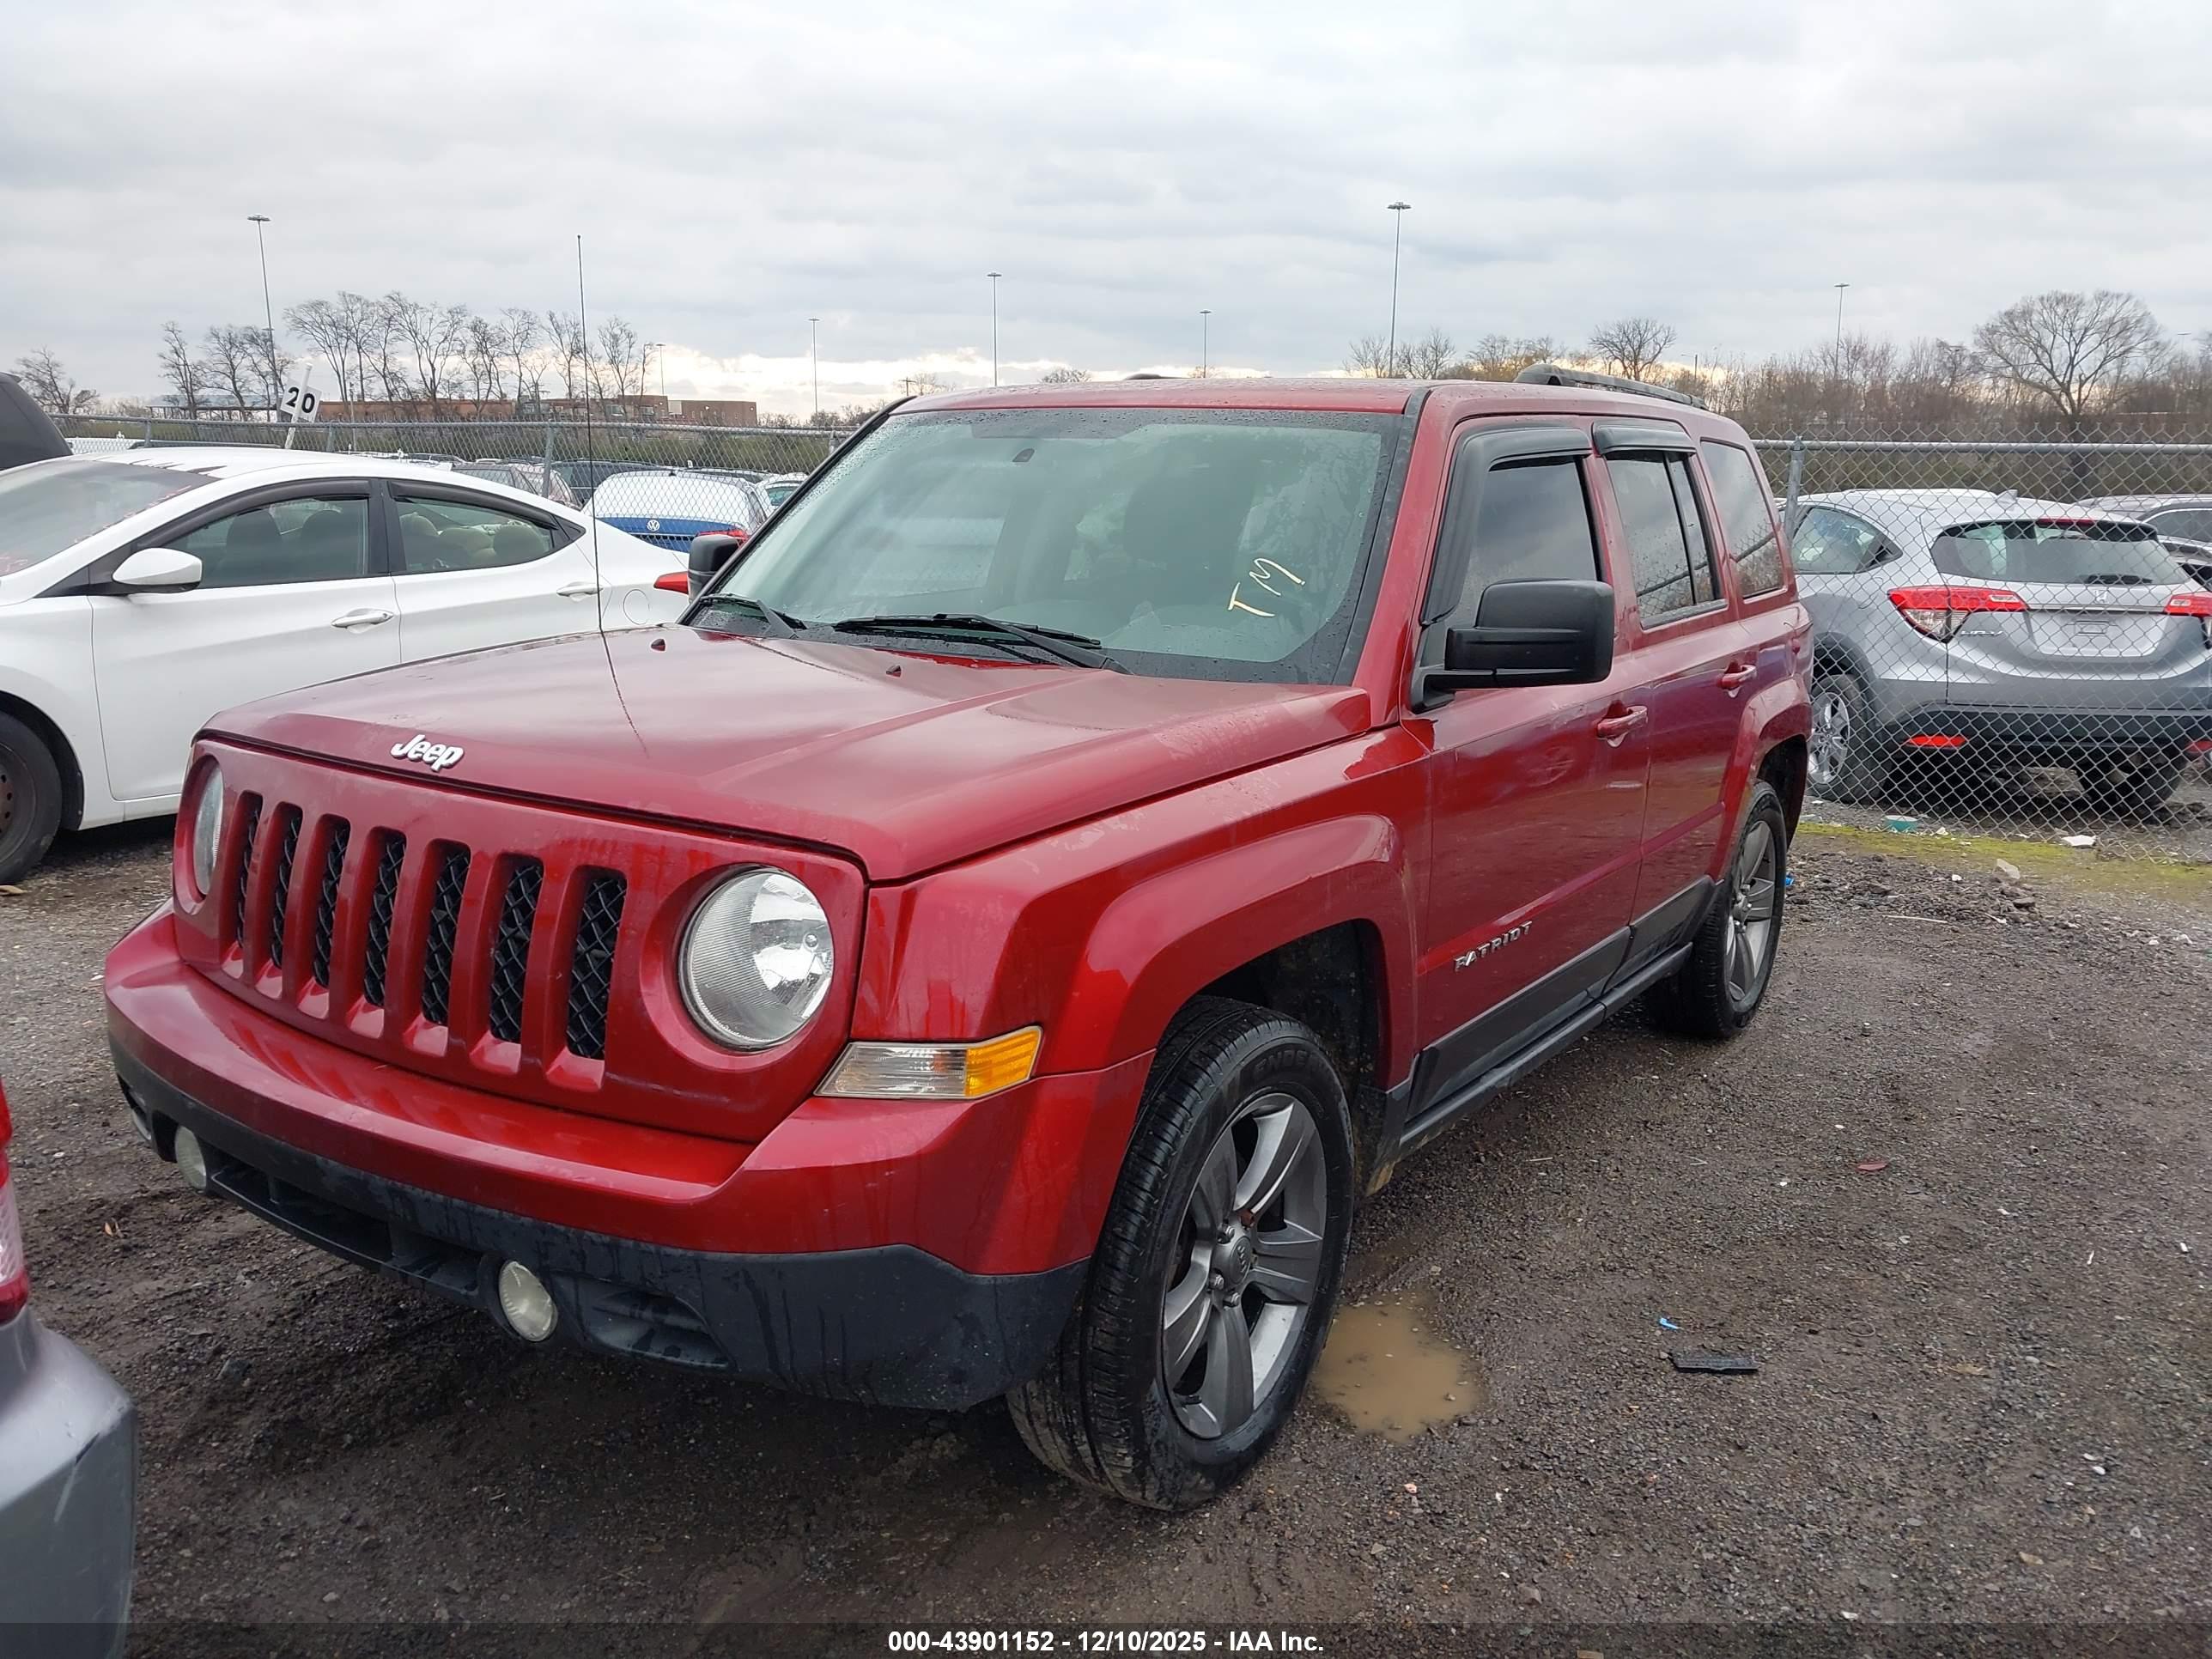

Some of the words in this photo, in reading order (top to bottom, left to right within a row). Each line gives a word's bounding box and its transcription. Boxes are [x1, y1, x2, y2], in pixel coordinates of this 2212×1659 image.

[285, 386, 315, 414] 20
[390, 733, 465, 773] Jeep
[1454, 921, 1533, 973] PATRIOT
